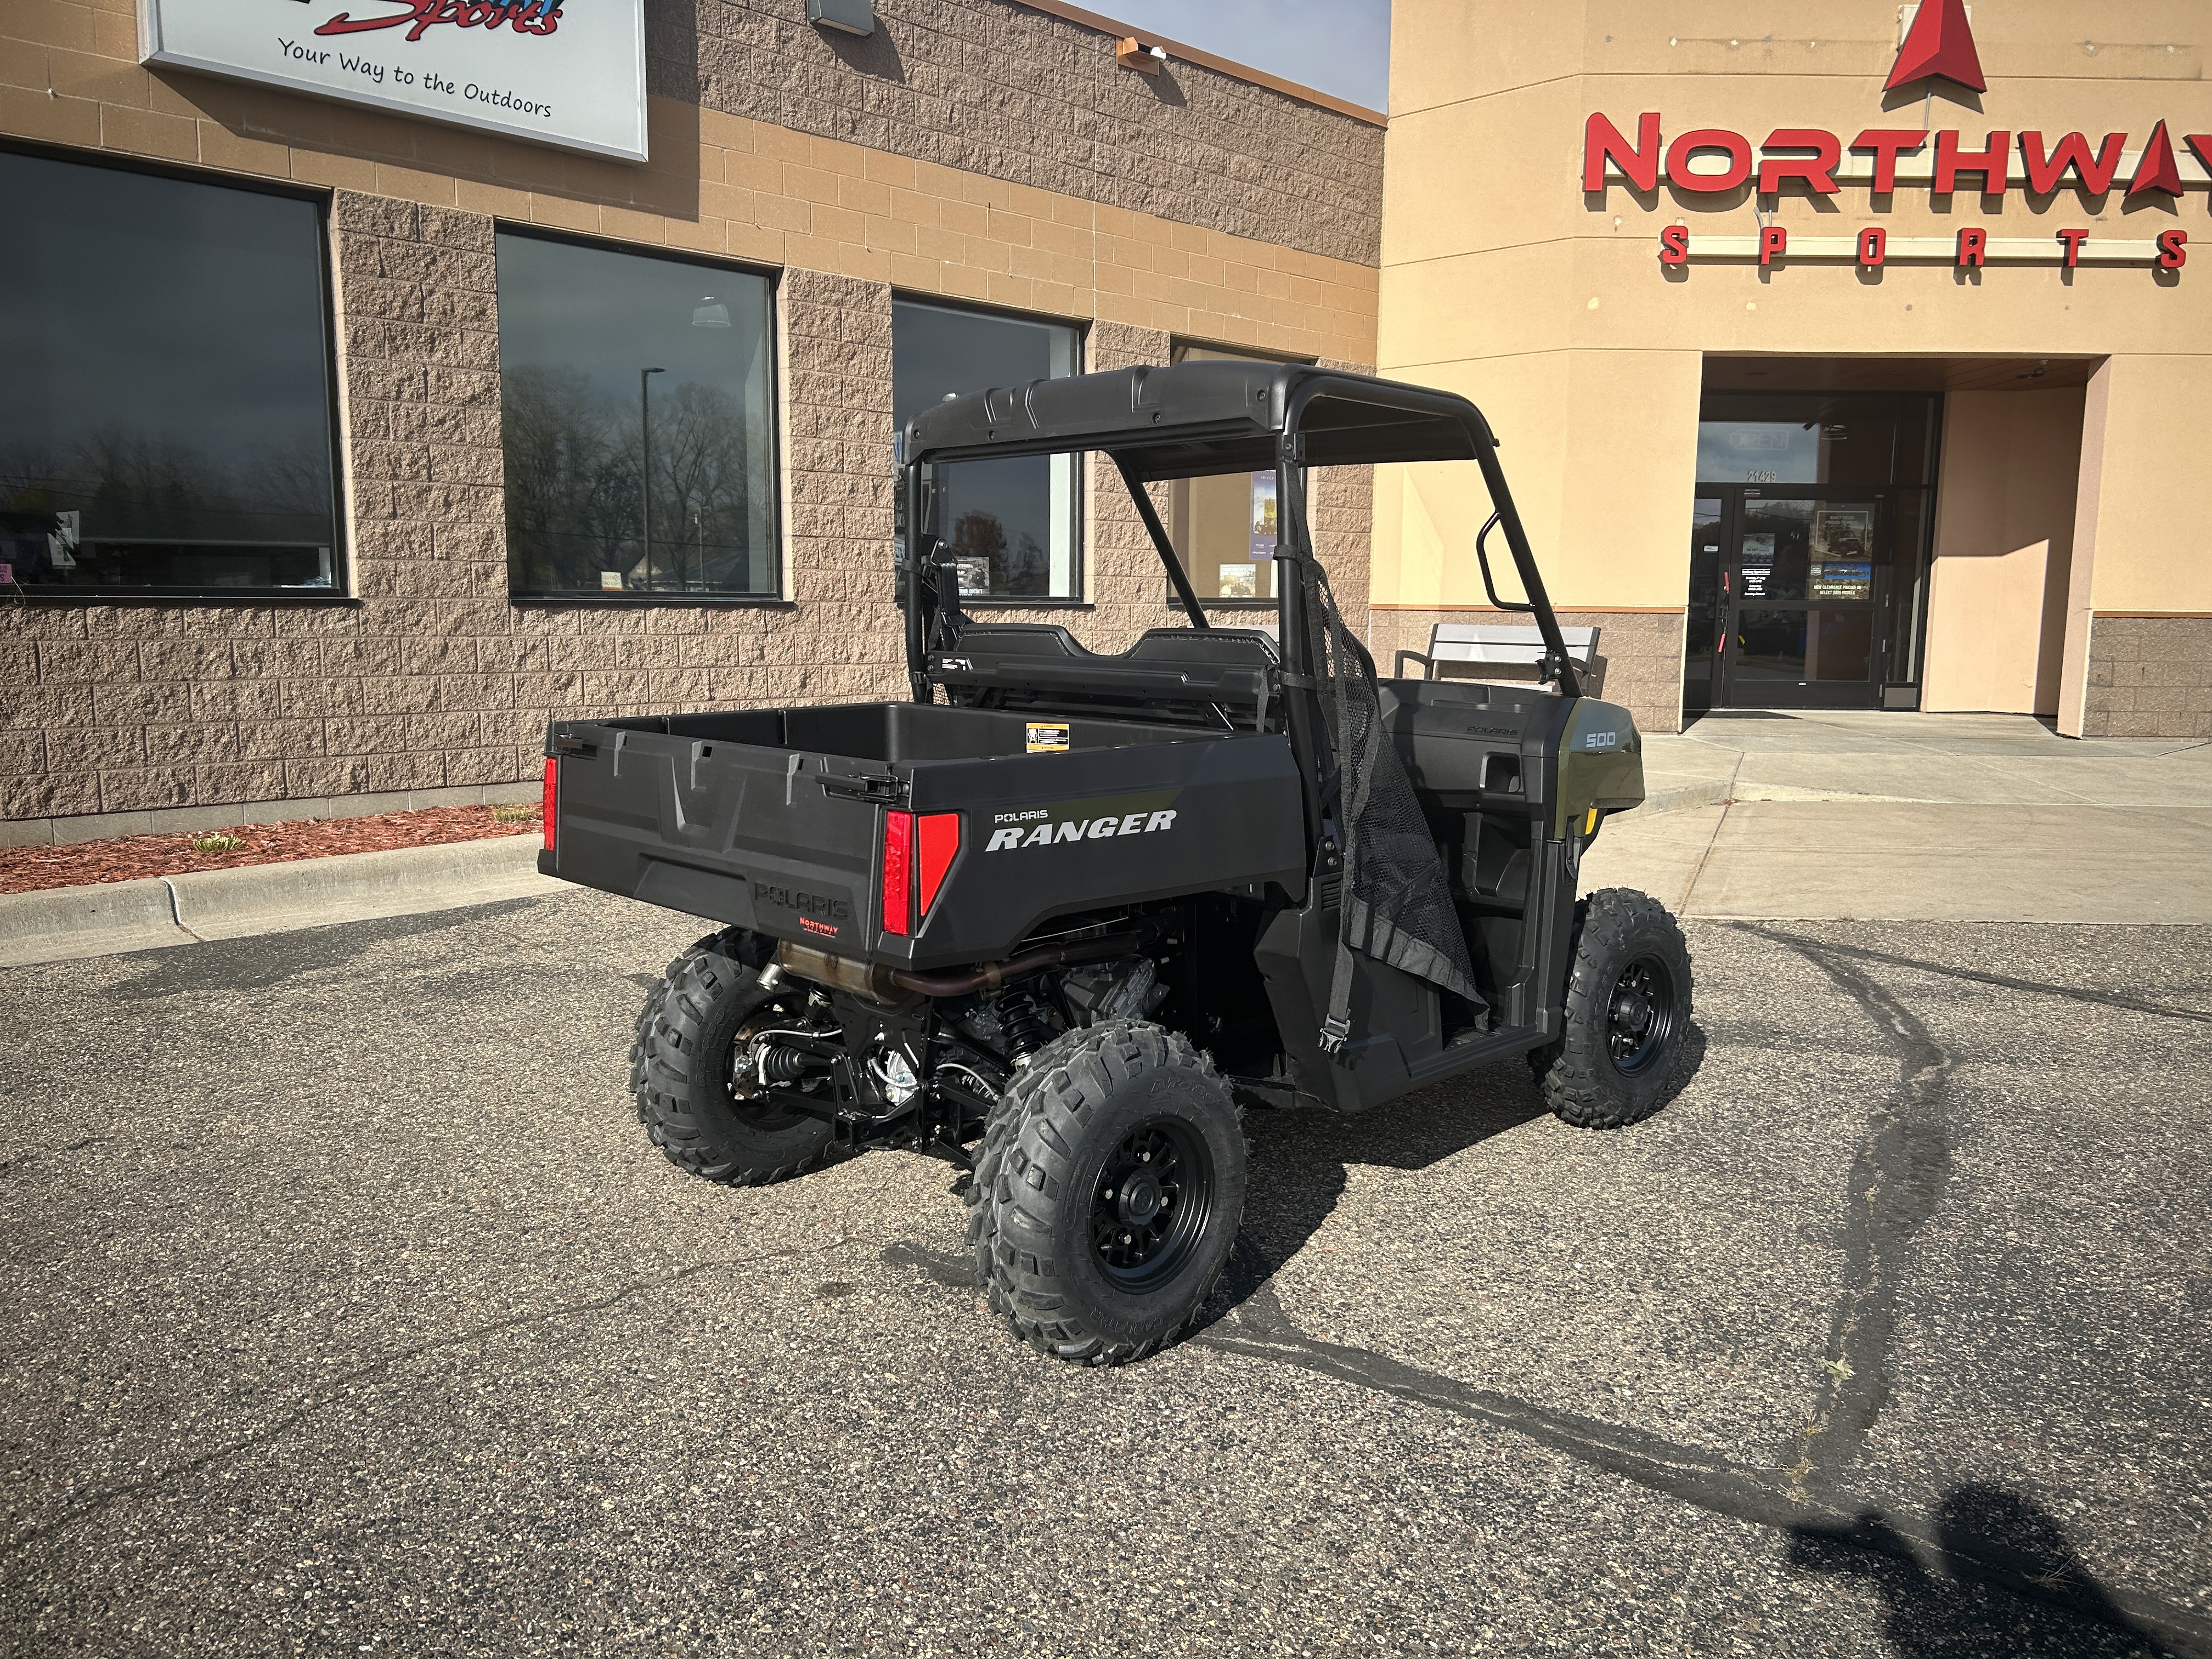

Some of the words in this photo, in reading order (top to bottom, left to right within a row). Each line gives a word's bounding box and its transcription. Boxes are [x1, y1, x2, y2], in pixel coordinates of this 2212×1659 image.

[278, 37, 330, 64] Your
[340, 53, 383, 83] Way
[394, 66, 414, 84] to
[423, 73, 455, 94] the
[464, 83, 551, 117] Outdoors
[1660, 225, 2187, 268] SPORTS
[1747, 471, 1776, 483] 21429
[1466, 726, 1519, 736] POLARIS
[1585, 732, 1616, 748] 500
[994, 809, 1049, 823] POLARIS
[985, 810, 1177, 852] RANGER
[755, 882, 850, 920] POLARIS
[799, 917, 839, 933] NORTHWAY
